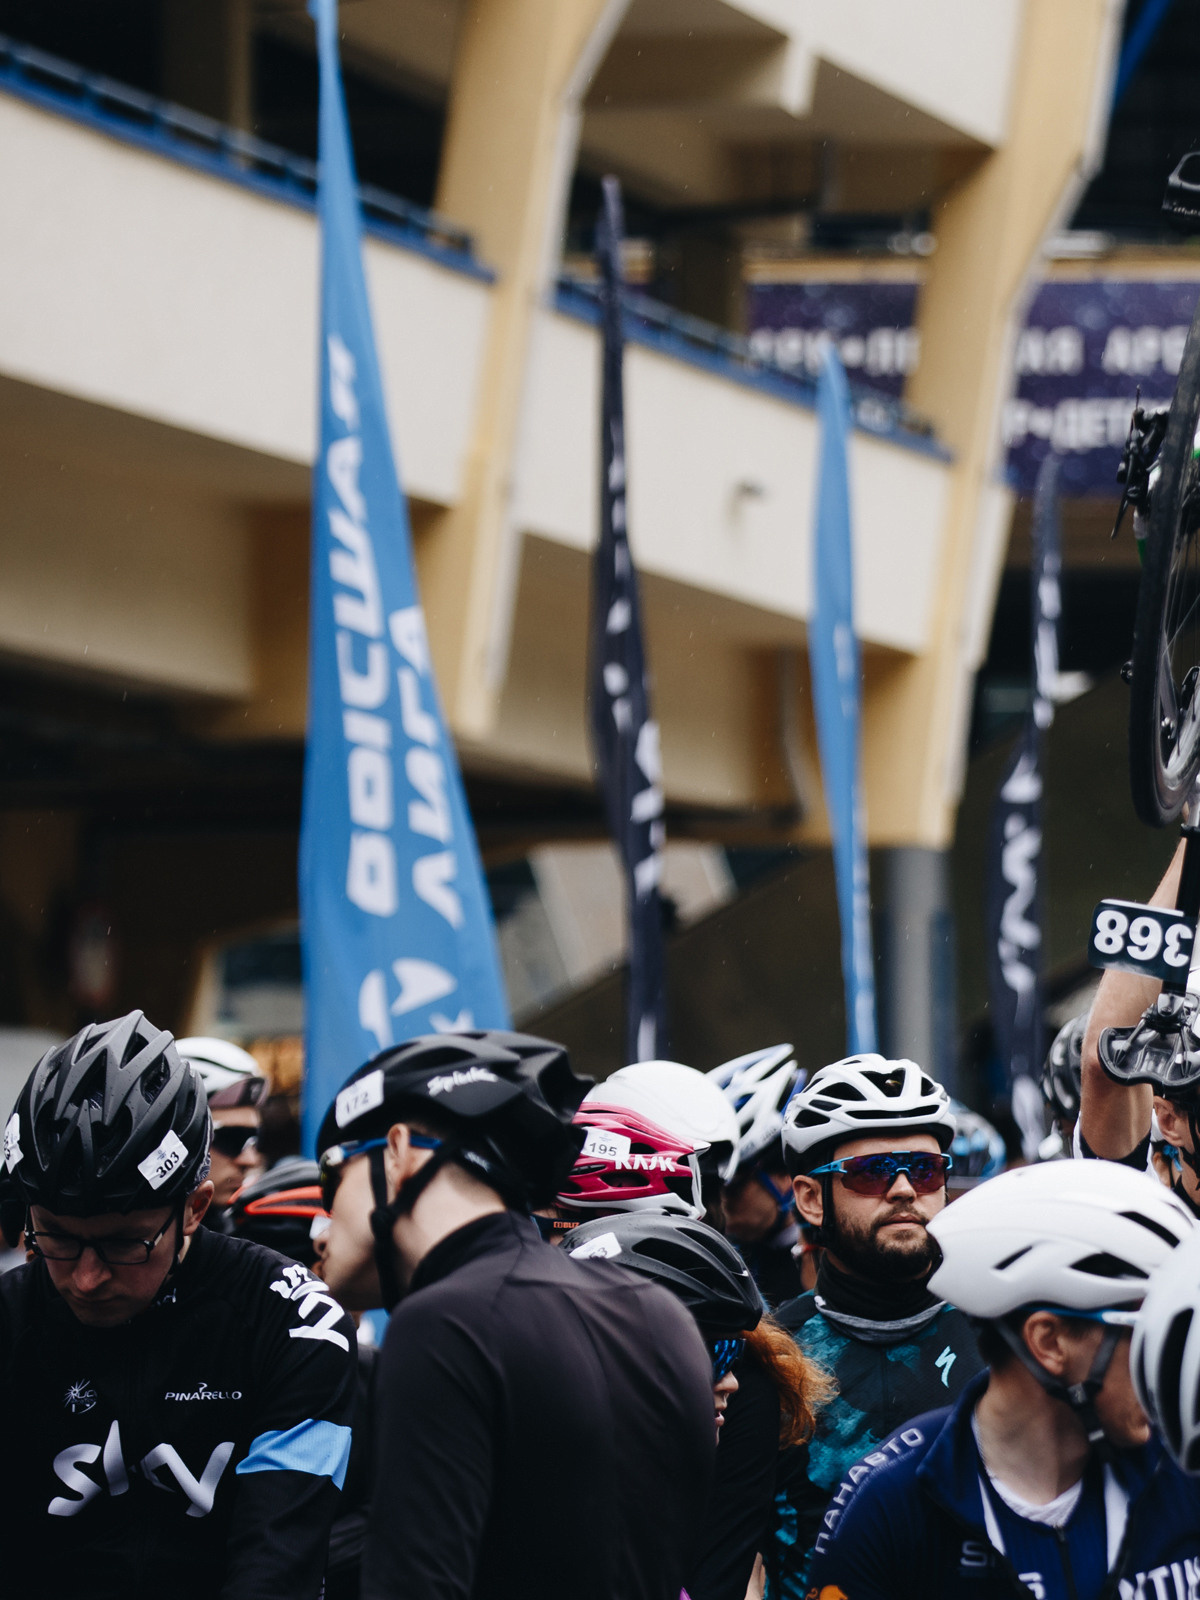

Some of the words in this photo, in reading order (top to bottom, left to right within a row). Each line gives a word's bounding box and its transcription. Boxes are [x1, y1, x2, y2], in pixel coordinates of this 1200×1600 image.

[1094, 910, 1193, 967] 368
[589, 1141, 618, 1157] 195
[155, 1150, 181, 1180] 303
[165, 1391, 242, 1402] PINARELLO
